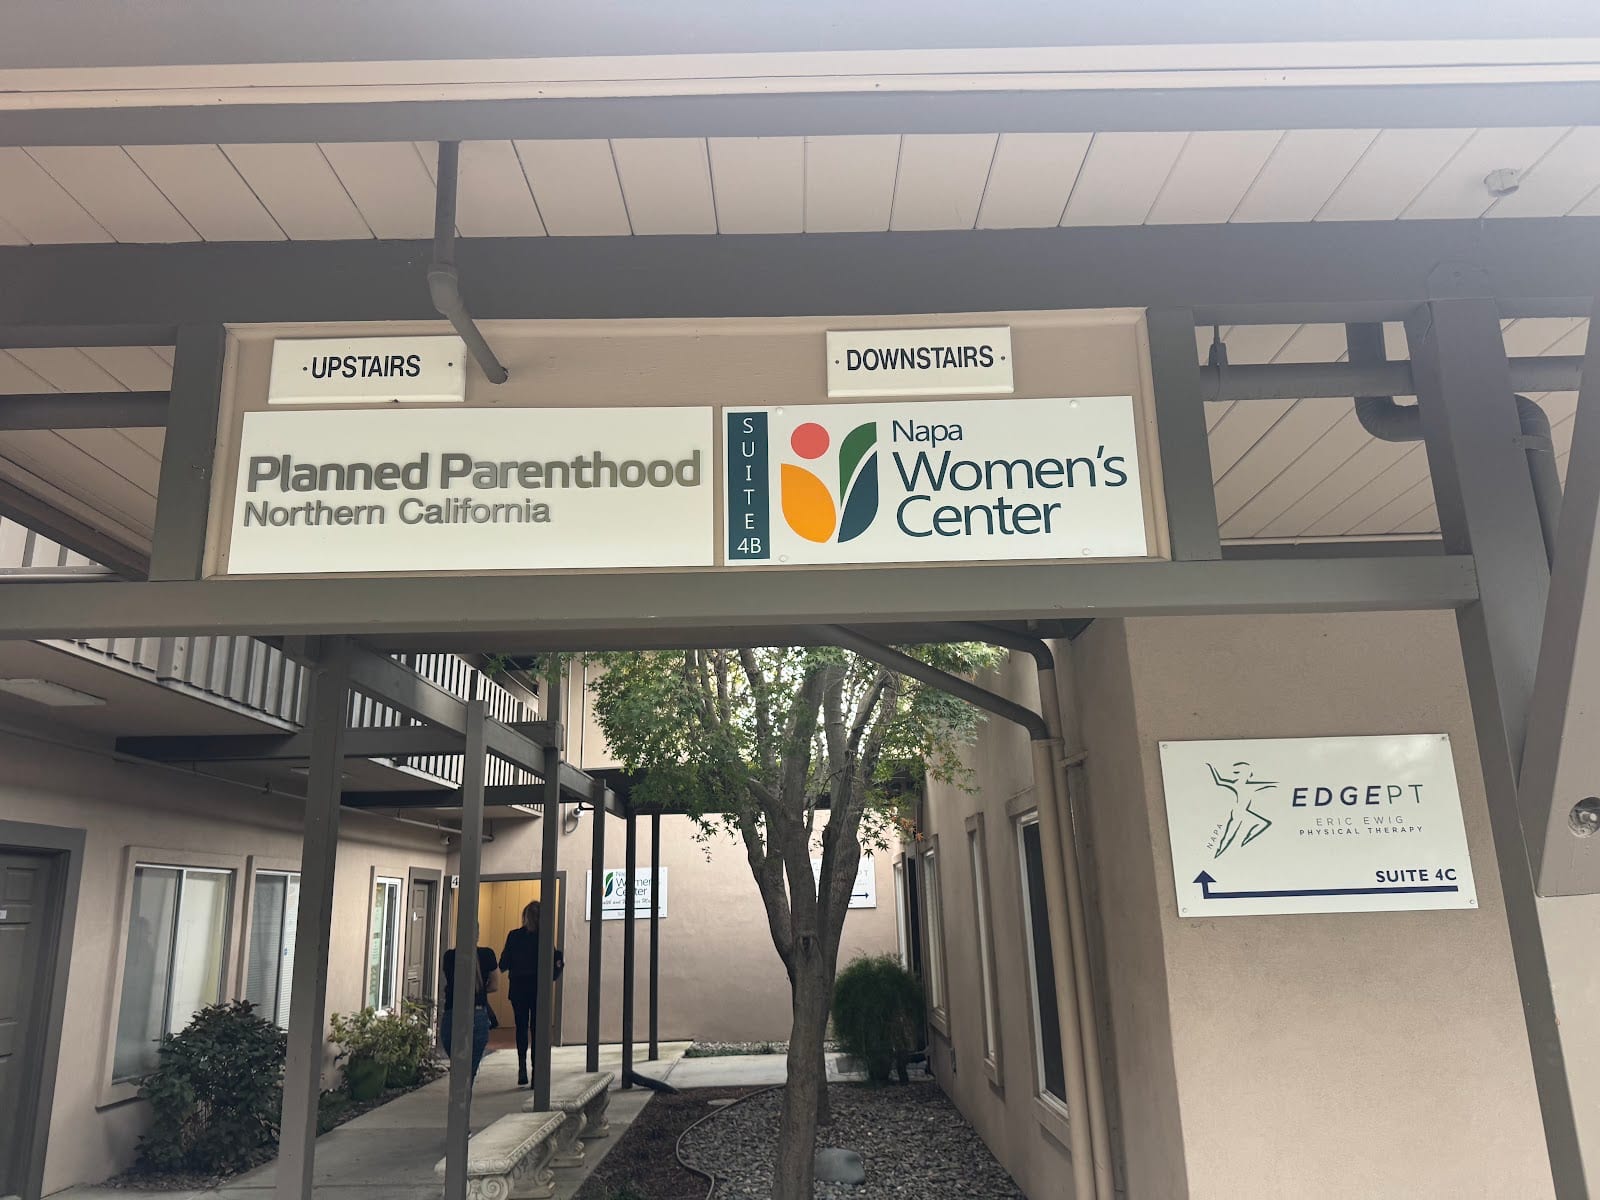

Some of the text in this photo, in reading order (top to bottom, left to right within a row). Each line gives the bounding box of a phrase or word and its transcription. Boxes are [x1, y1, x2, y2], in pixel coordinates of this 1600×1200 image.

[311, 354, 421, 378] UPSTAIRS
[846, 345, 994, 371] DOWNSTAIRS
[892, 419, 963, 449] Napa
[247, 449, 701, 493] Planned Parenthood
[892, 444, 1128, 493] Women's
[737, 417, 762, 554] SUITE 4B
[243, 497, 551, 528] Northern California
[896, 494, 1062, 538] Center
[1299, 825, 1423, 836] PHYSICAL THERAPY
[1315, 815, 1405, 827] ERIC EWIG
[1206, 823, 1224, 850] NAPA
[1375, 867, 1458, 883] SUITE 4C
[615, 887, 648, 897] Cter
